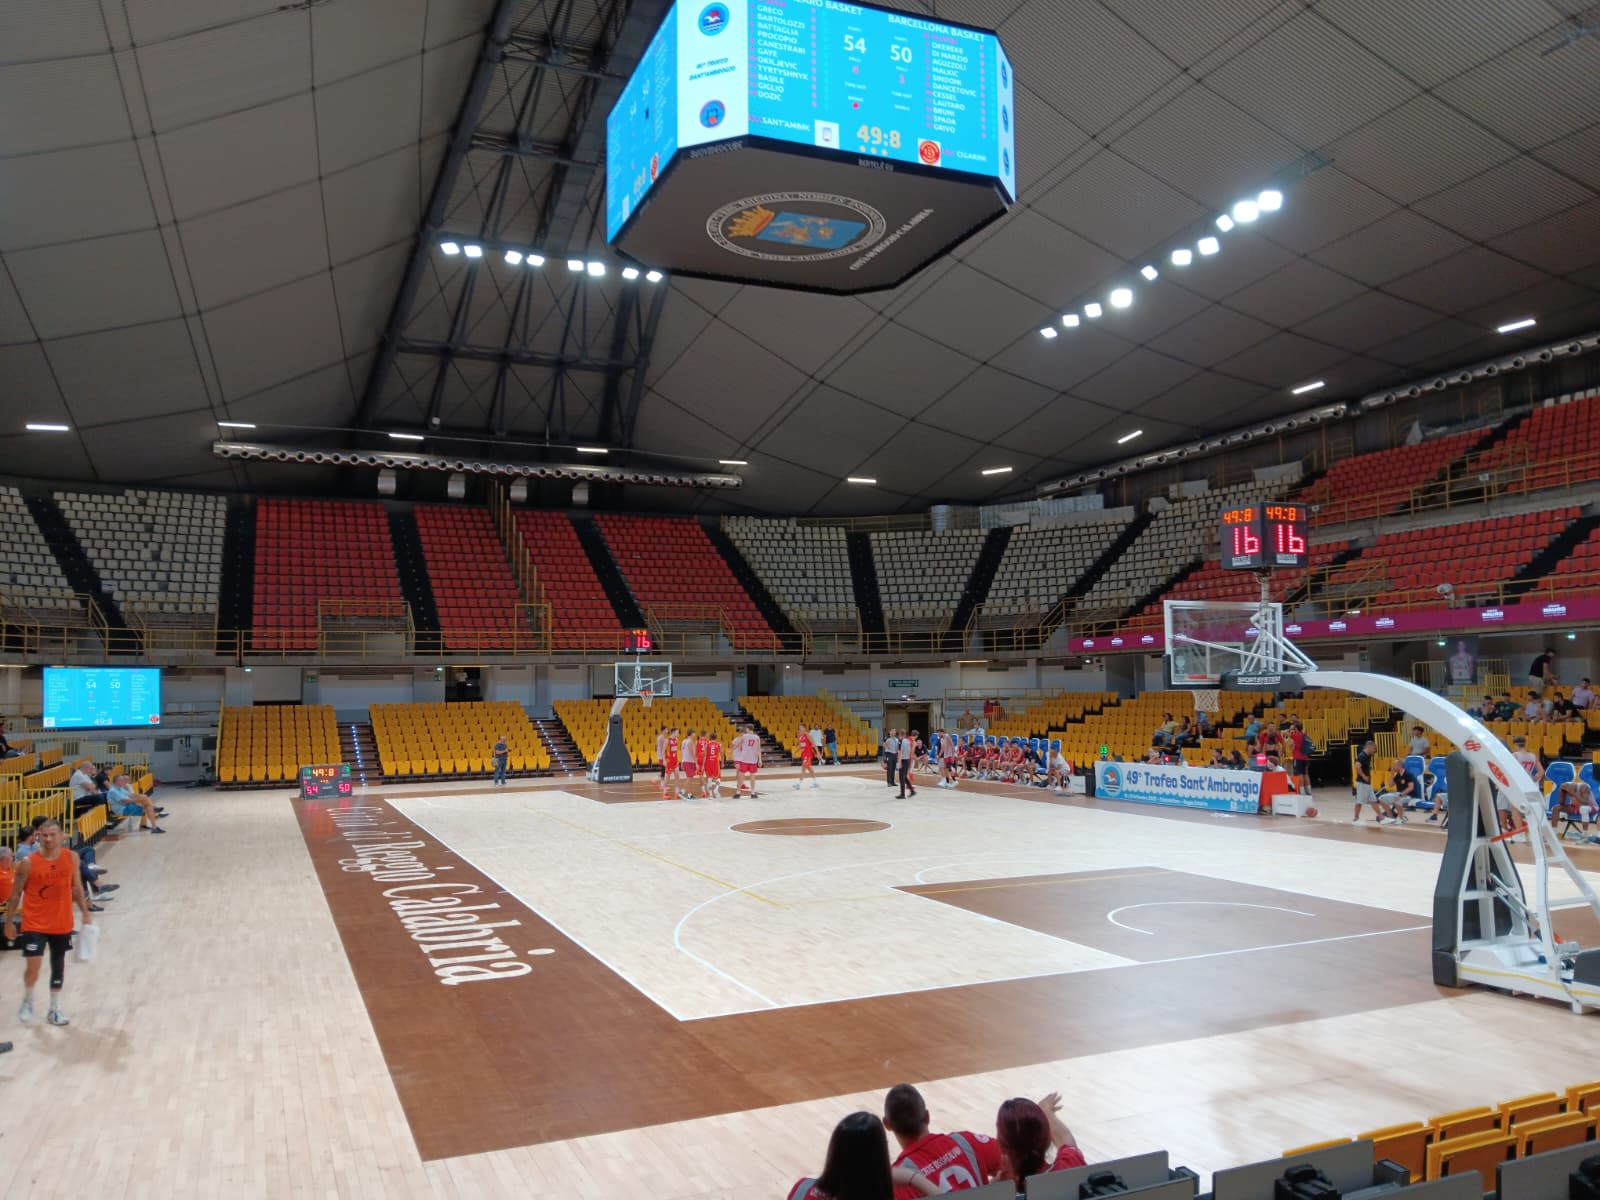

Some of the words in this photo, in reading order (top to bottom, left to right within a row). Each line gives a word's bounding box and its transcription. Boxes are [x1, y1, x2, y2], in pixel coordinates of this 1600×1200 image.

[825, 0, 863, 15] BASKET
[888, 14, 949, 35] BARCELLONA
[951, 26, 985, 42] BASKET
[843, 34, 867, 54] 54
[890, 44, 913, 63] 50
[856, 124, 901, 148] 49:8
[1224, 508, 1252, 525] 49:8
[1266, 506, 1297, 522] 49:8
[1234, 526, 1260, 555] 16
[1278, 524, 1305, 553] 16
[637, 636, 650, 648] 16
[312, 768, 335, 777] 49:8
[306, 786, 319, 795] 54
[338, 783, 350, 792] 50
[1144, 772, 1178, 788] Trofeo
[1180, 774, 1259, 798] Sant'Ambrogio
[338, 840, 455, 882] Reggio
[382, 882, 556, 986] Calabria
